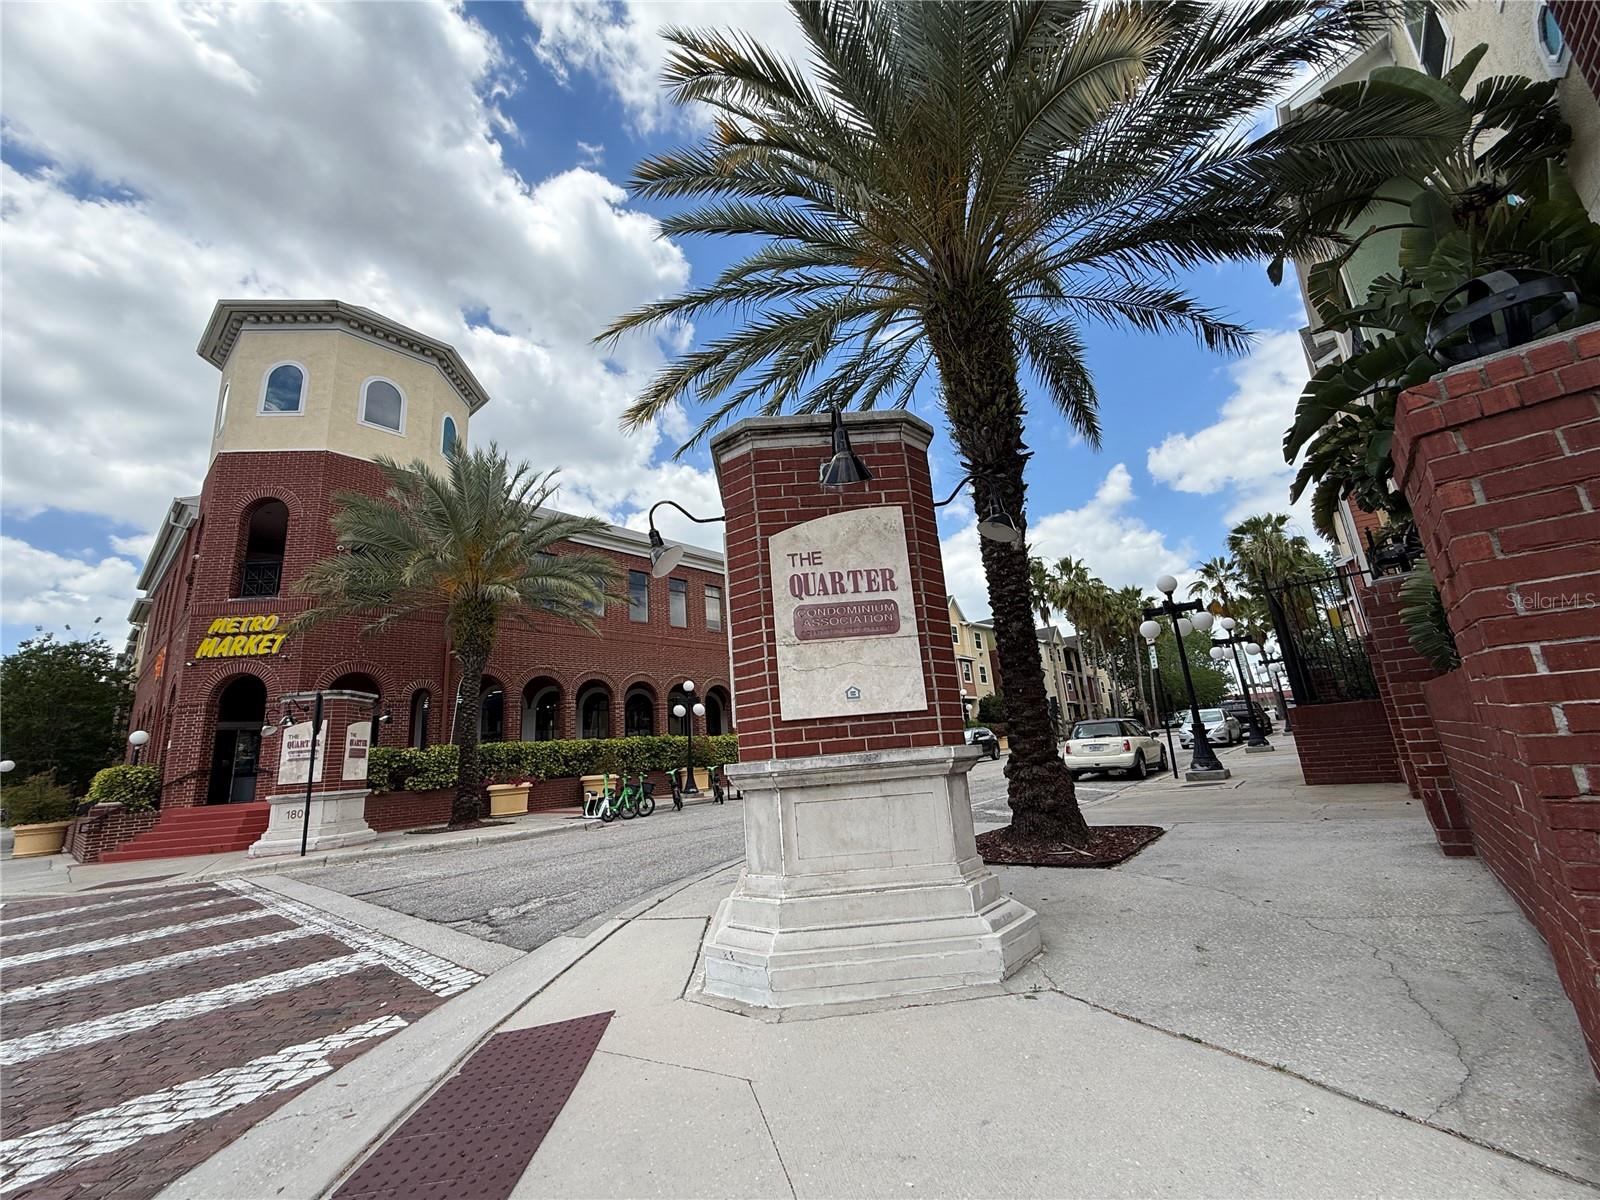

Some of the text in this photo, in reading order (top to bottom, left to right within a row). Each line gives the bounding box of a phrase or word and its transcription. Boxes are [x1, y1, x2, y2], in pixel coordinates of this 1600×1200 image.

[787, 551, 823, 567] THE
[789, 568, 899, 600] QUARTER
[797, 603, 895, 618] CONDOMINIUM
[207, 614, 280, 634] METRO
[803, 614, 893, 627] ASSOCIATION
[195, 633, 288, 659] MARKET
[287, 739, 320, 750] QUARTR
